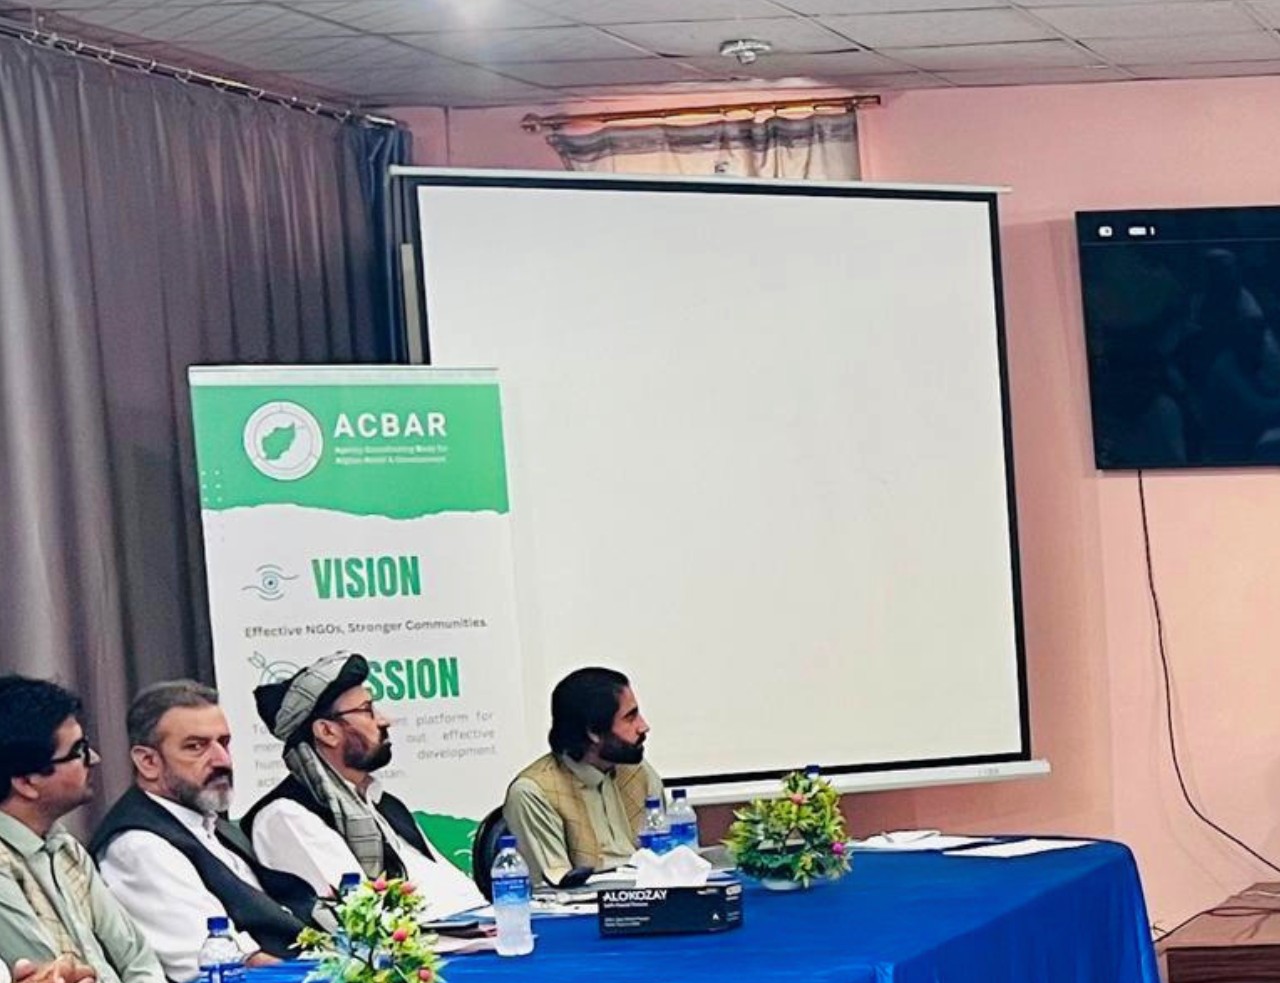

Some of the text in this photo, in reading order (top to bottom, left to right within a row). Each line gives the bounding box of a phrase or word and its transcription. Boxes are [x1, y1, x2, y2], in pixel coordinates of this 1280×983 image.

[333, 412, 447, 438] ACBAR
[311, 555, 422, 600] VISION
[245, 626, 303, 639] Effective
[347, 622, 403, 635] Stronger
[367, 656, 460, 701] SSION
[602, 889, 668, 902] ALOKOZAY
